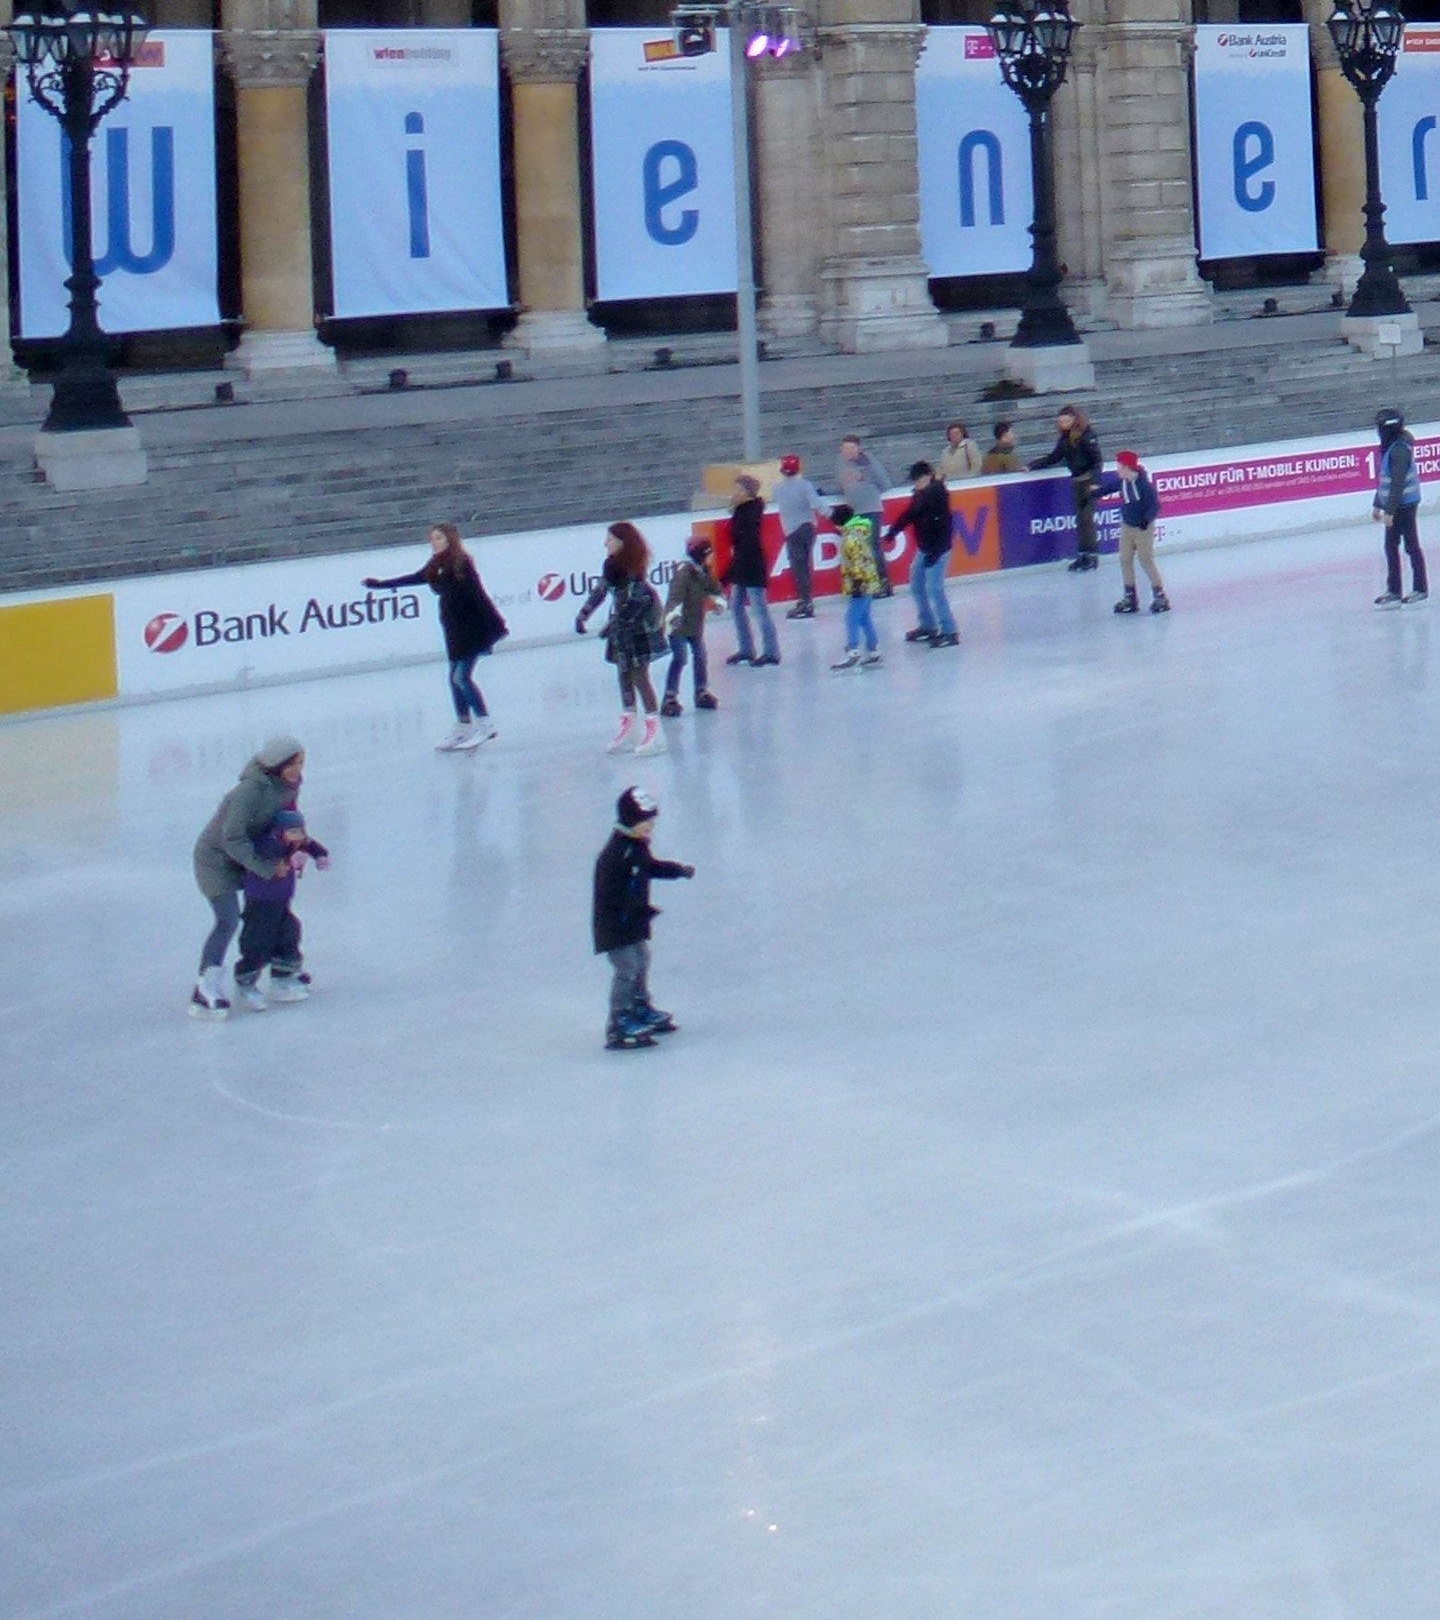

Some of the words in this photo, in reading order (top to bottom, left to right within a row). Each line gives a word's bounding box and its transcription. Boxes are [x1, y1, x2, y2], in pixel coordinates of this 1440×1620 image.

[1255, 34, 1286, 46] Austria
[642, 139, 700, 247] e
[958, 128, 1004, 228] n
[1232, 121, 1275, 213] e
[1412, 115, 1437, 201] r
[1157, 472, 1217, 492] EXKLUSIV
[1220, 467, 1244, 484] FÜR
[1247, 460, 1303, 481] T-MOBILE
[1305, 454, 1360, 472] KUNDEN:
[195, 604, 290, 647] Bank
[300, 586, 420, 634] Austria
